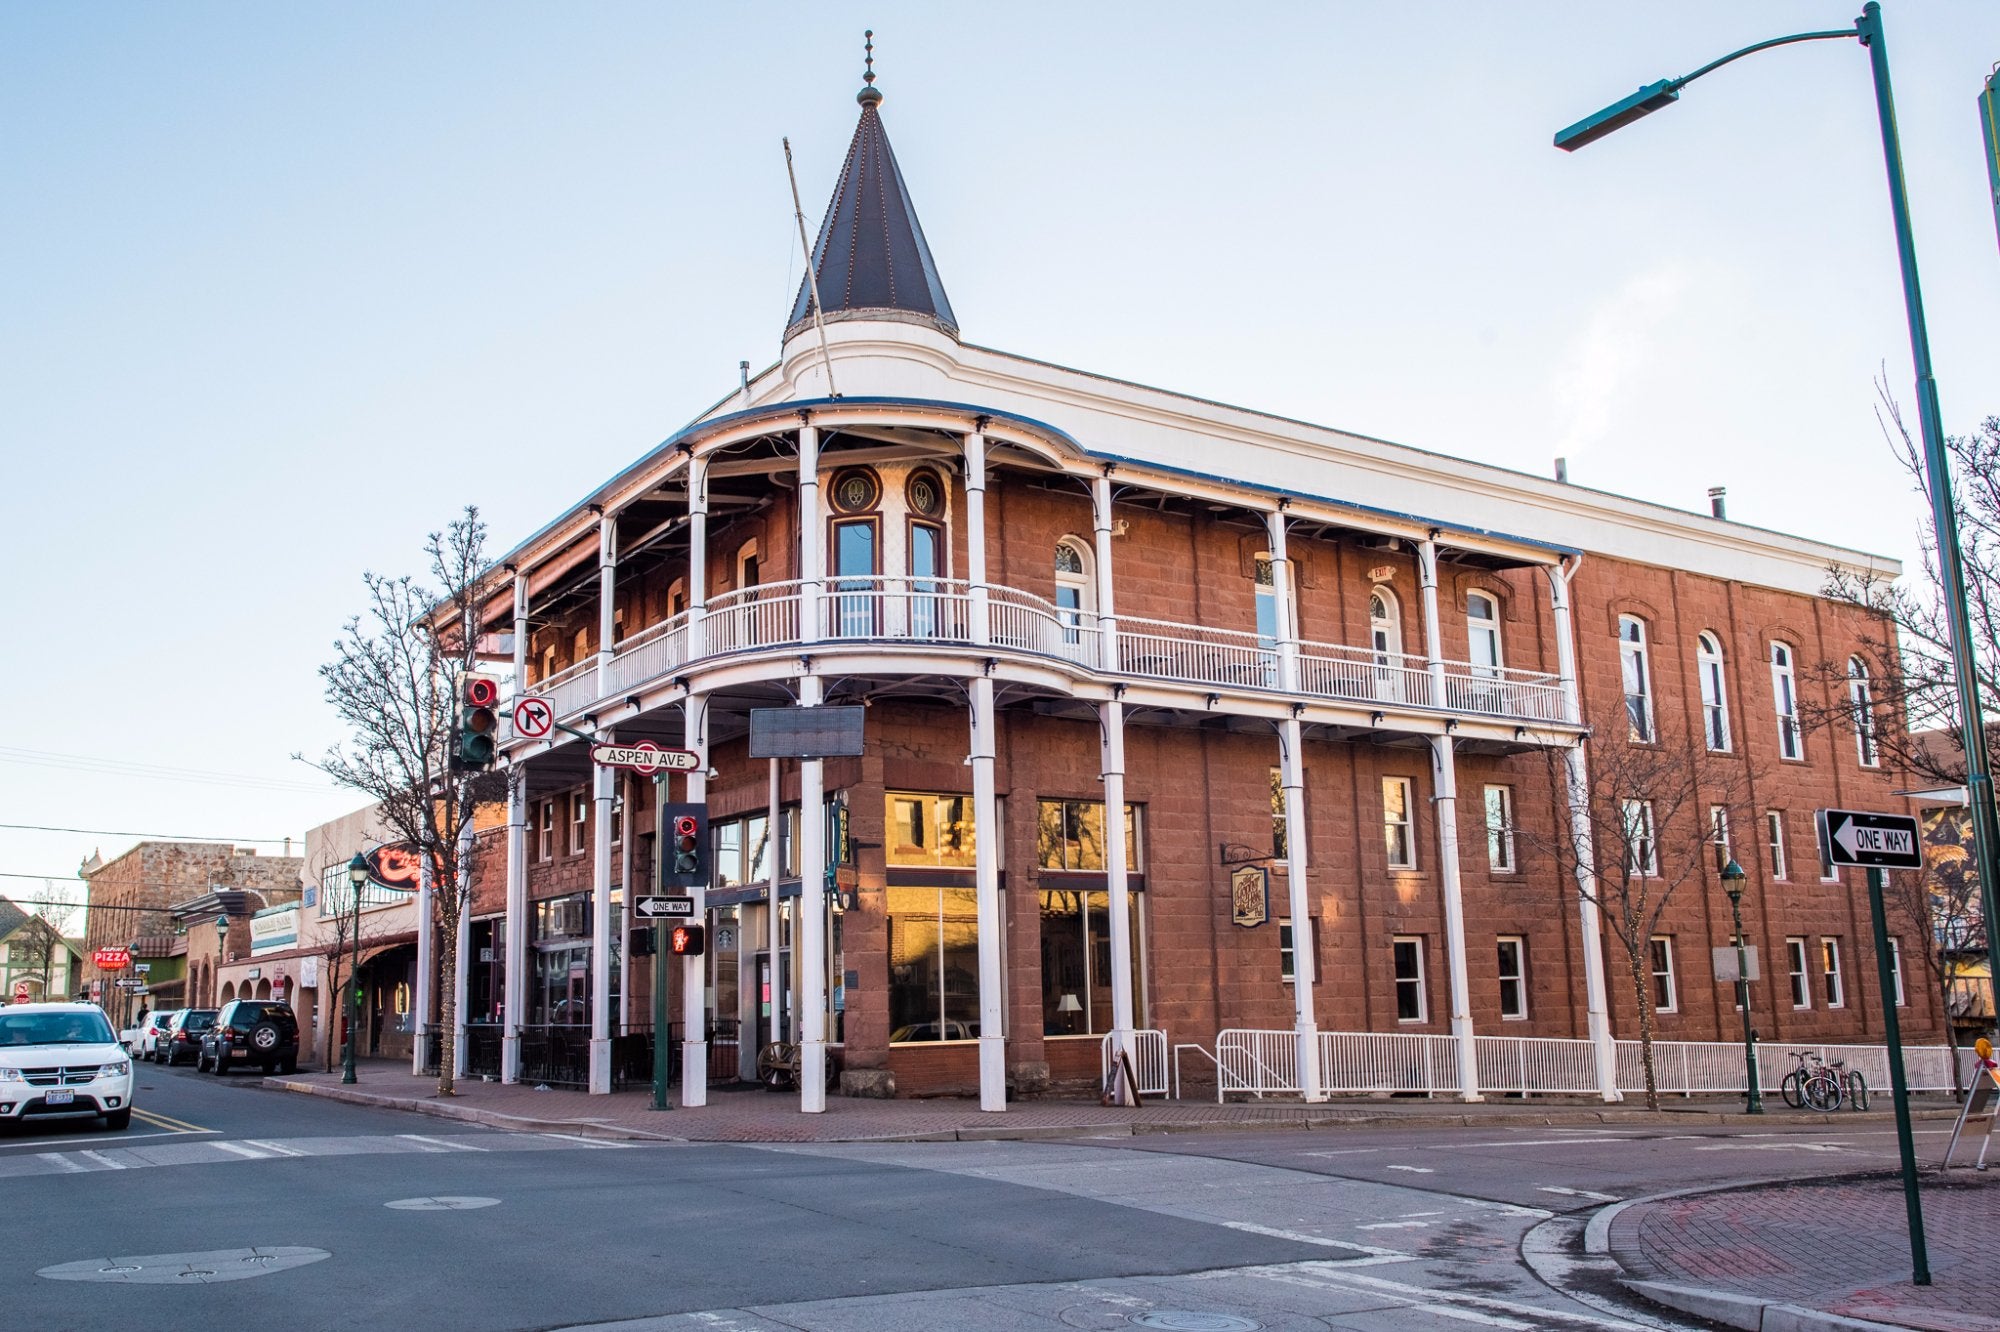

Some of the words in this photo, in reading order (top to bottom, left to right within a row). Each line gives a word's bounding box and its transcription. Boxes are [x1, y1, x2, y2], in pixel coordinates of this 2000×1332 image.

[607, 750, 653, 764] ASPEN
[658, 754, 686, 767] AVE
[840, 809, 848, 863] HOTEL
[1856, 829, 1881, 850] ONE
[1883, 831, 1908, 852] WAY
[759, 888, 768, 897] 23
[653, 902, 670, 911] ONE
[671, 902, 689, 911] WAY
[94, 952, 130, 961] PIZZA
